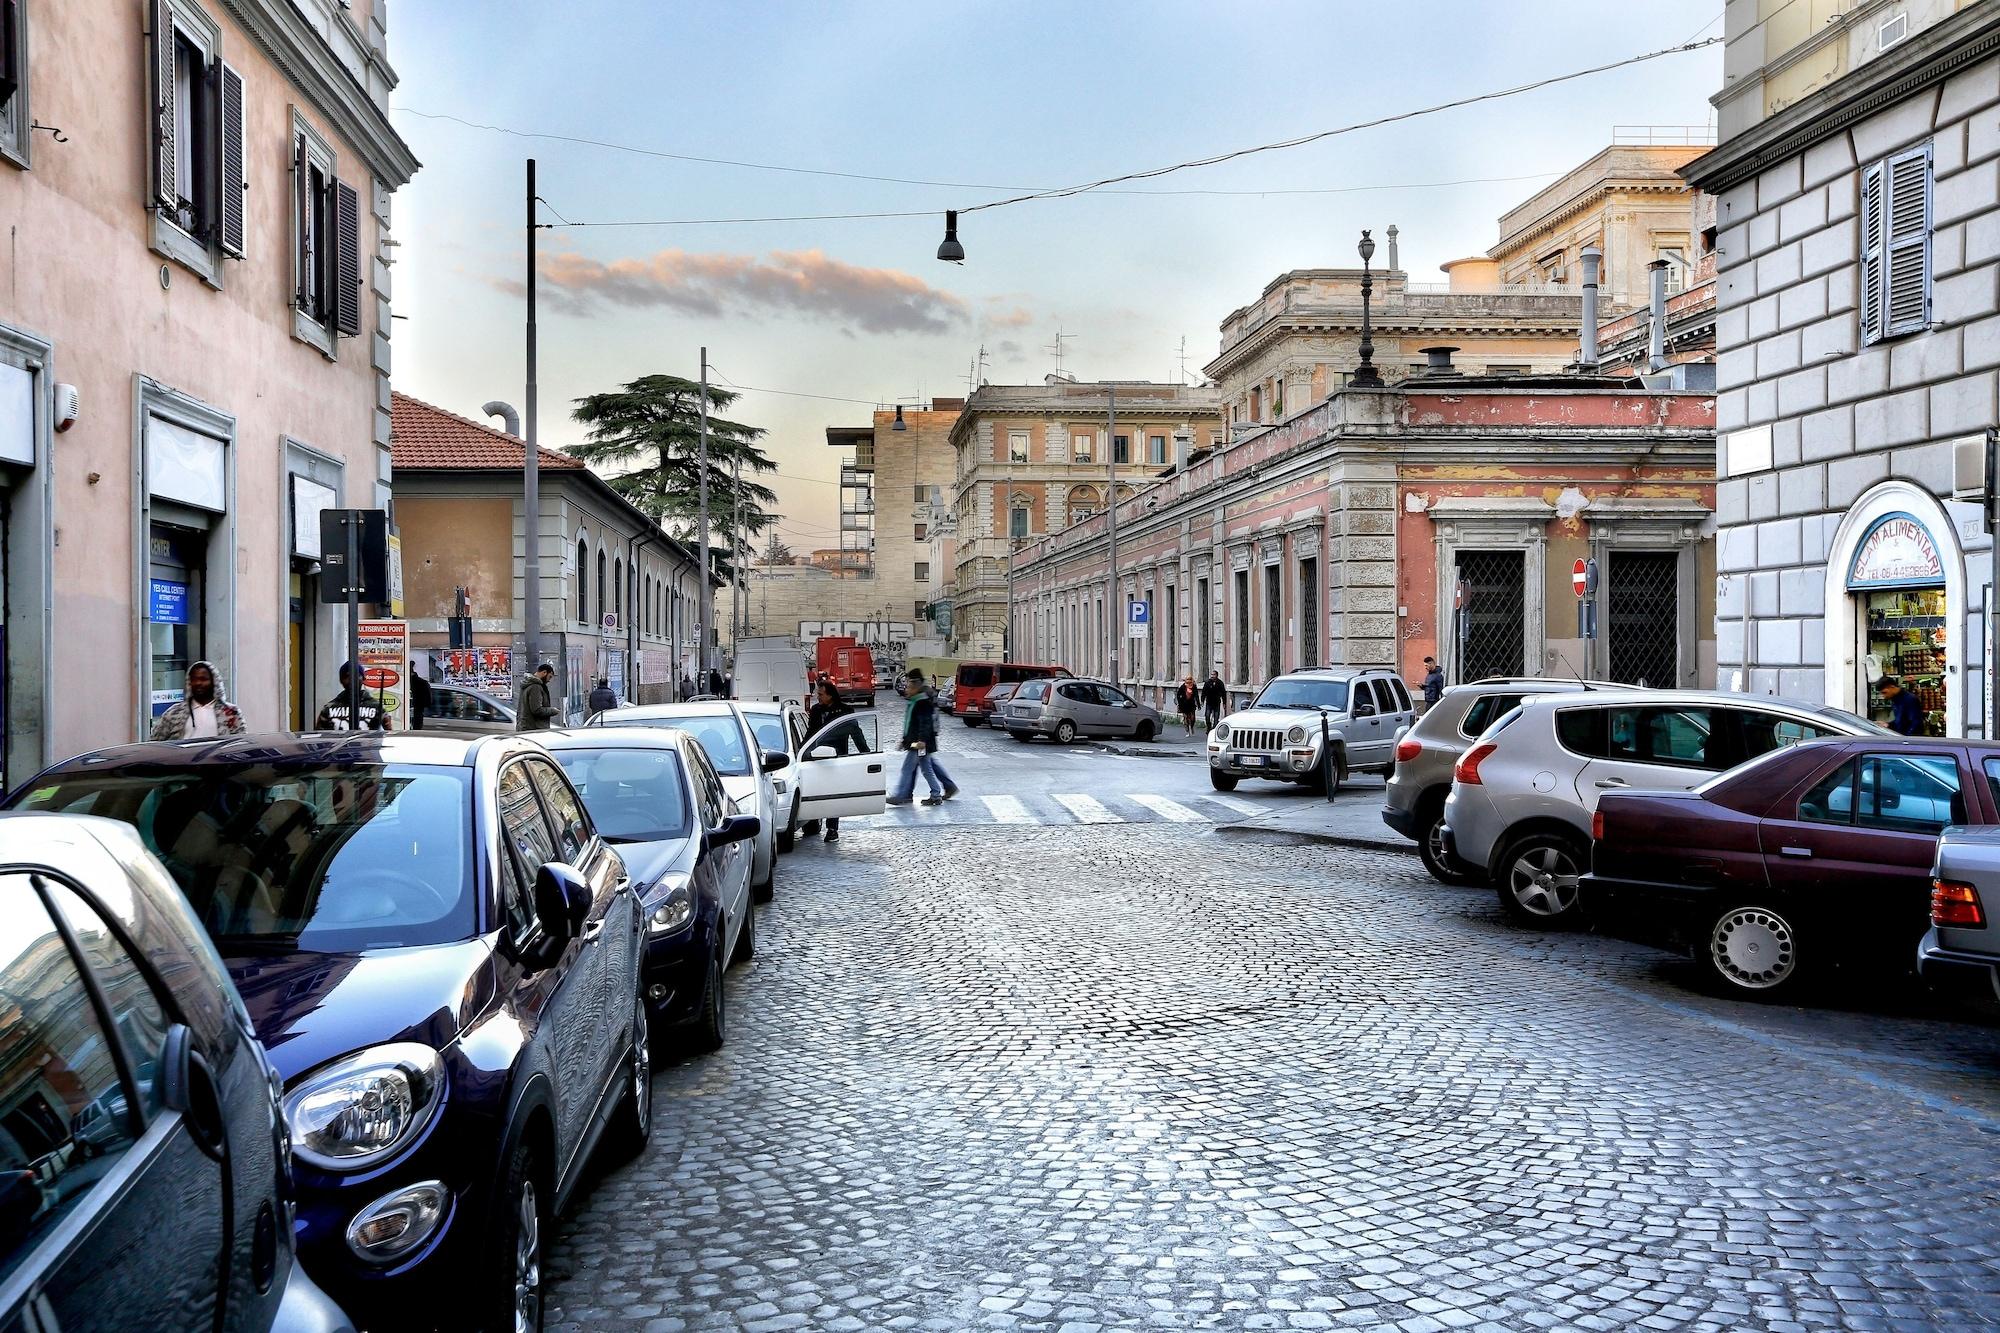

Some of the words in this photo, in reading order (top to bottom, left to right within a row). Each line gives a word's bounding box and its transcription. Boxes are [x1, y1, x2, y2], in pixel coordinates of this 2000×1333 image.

[1853, 532, 1882, 580] ISLAM
[1882, 521, 1940, 576] ALIMENTARI
[1132, 603, 1145, 621] P
[358, 625, 388, 633] ULTISERVICE
[389, 625, 404, 633] POINT
[377, 637, 402, 645] Transfer
[329, 706, 376, 718] WAING
